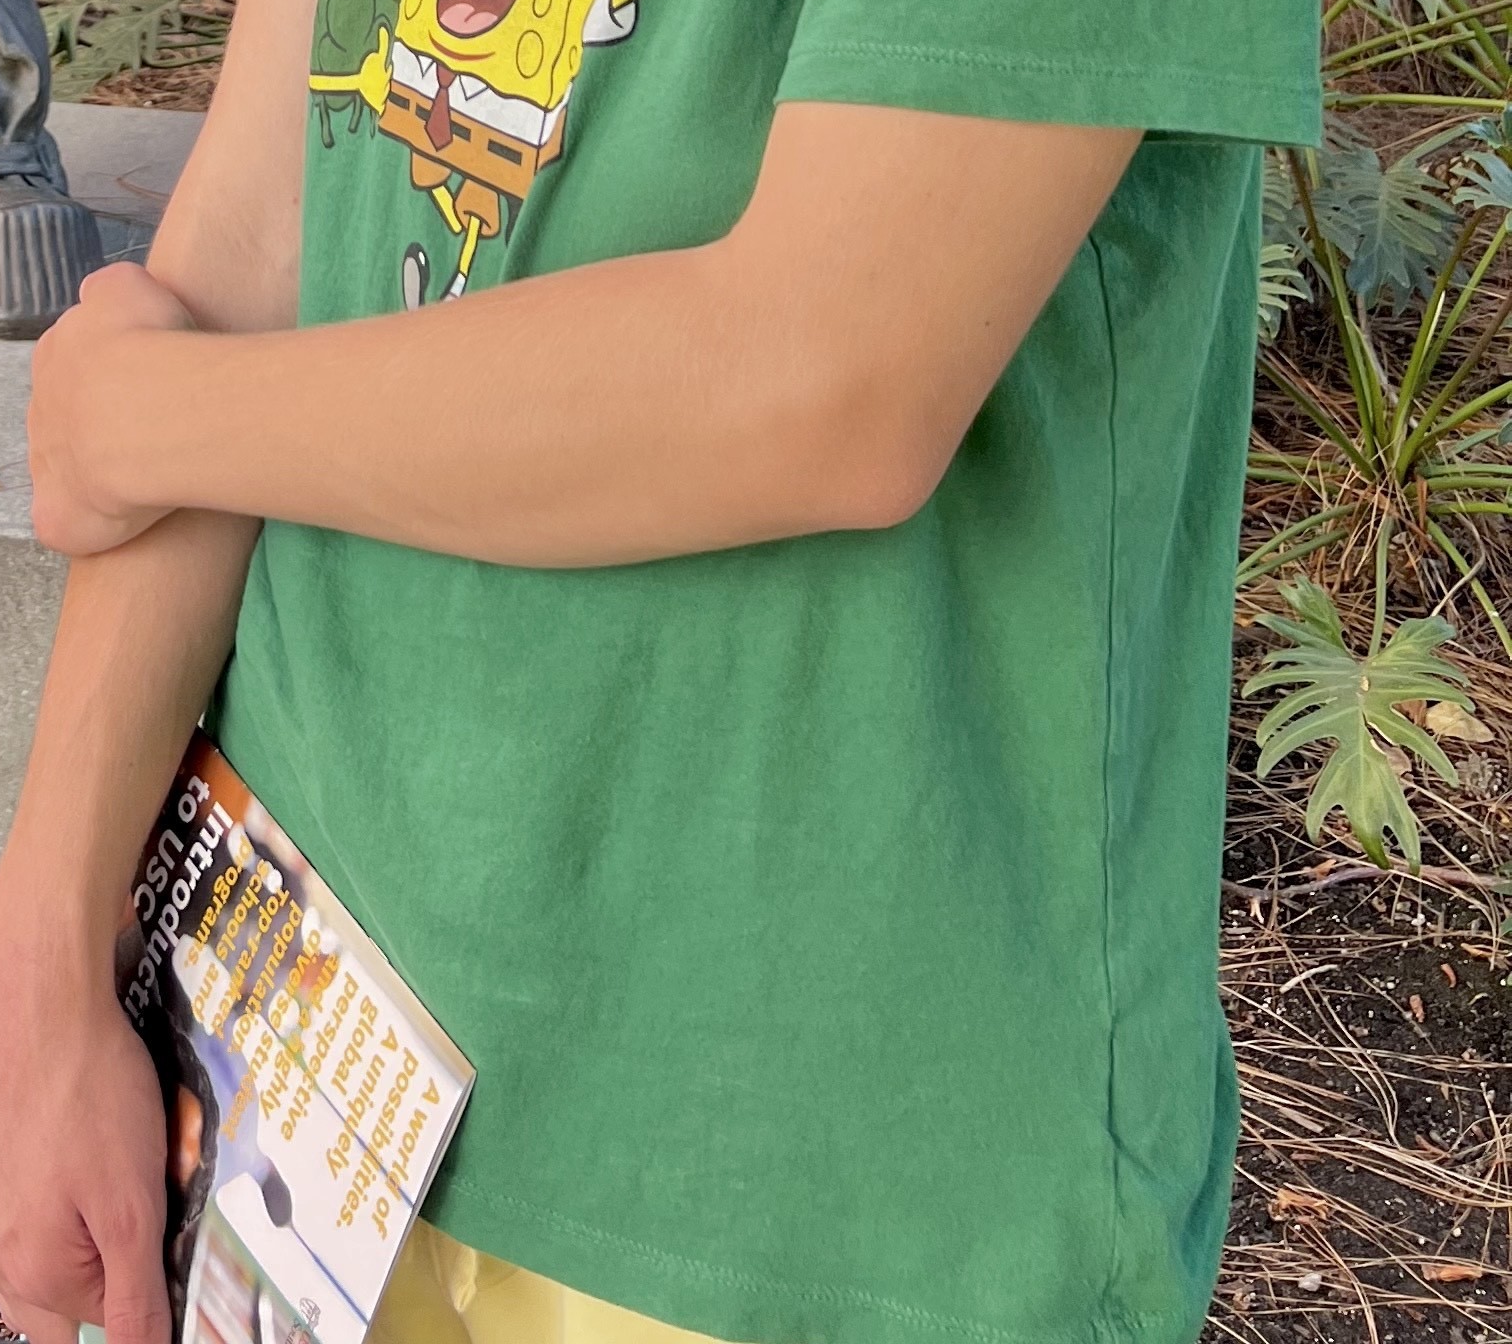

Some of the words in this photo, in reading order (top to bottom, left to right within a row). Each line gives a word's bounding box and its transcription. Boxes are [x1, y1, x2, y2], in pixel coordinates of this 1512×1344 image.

[177, 775, 207, 824] to
[125, 801, 233, 1027] Introducti
[133, 830, 182, 921] USC
[184, 834, 252, 968] programs.
[214, 859, 270, 960] schools
[188, 962, 221, 1023] and
[210, 888, 288, 1040] Top-ranked
[228, 899, 304, 1053] population.
[267, 929, 320, 1032] diverse
[308, 954, 339, 1012] and
[279, 972, 359, 1141] perspective
[297, 1008, 311, 1031] a
[331, 996, 378, 1095] global
[380, 1026, 398, 1052] A
[222, 1031, 274, 1141] student
[262, 1034, 304, 1120] highly
[328, 1055, 385, 1180] uniquely
[421, 1077, 439, 1106] A
[336, 1048, 419, 1228] possibilities.
[384, 1109, 427, 1200] world
[372, 1197, 389, 1241] of
